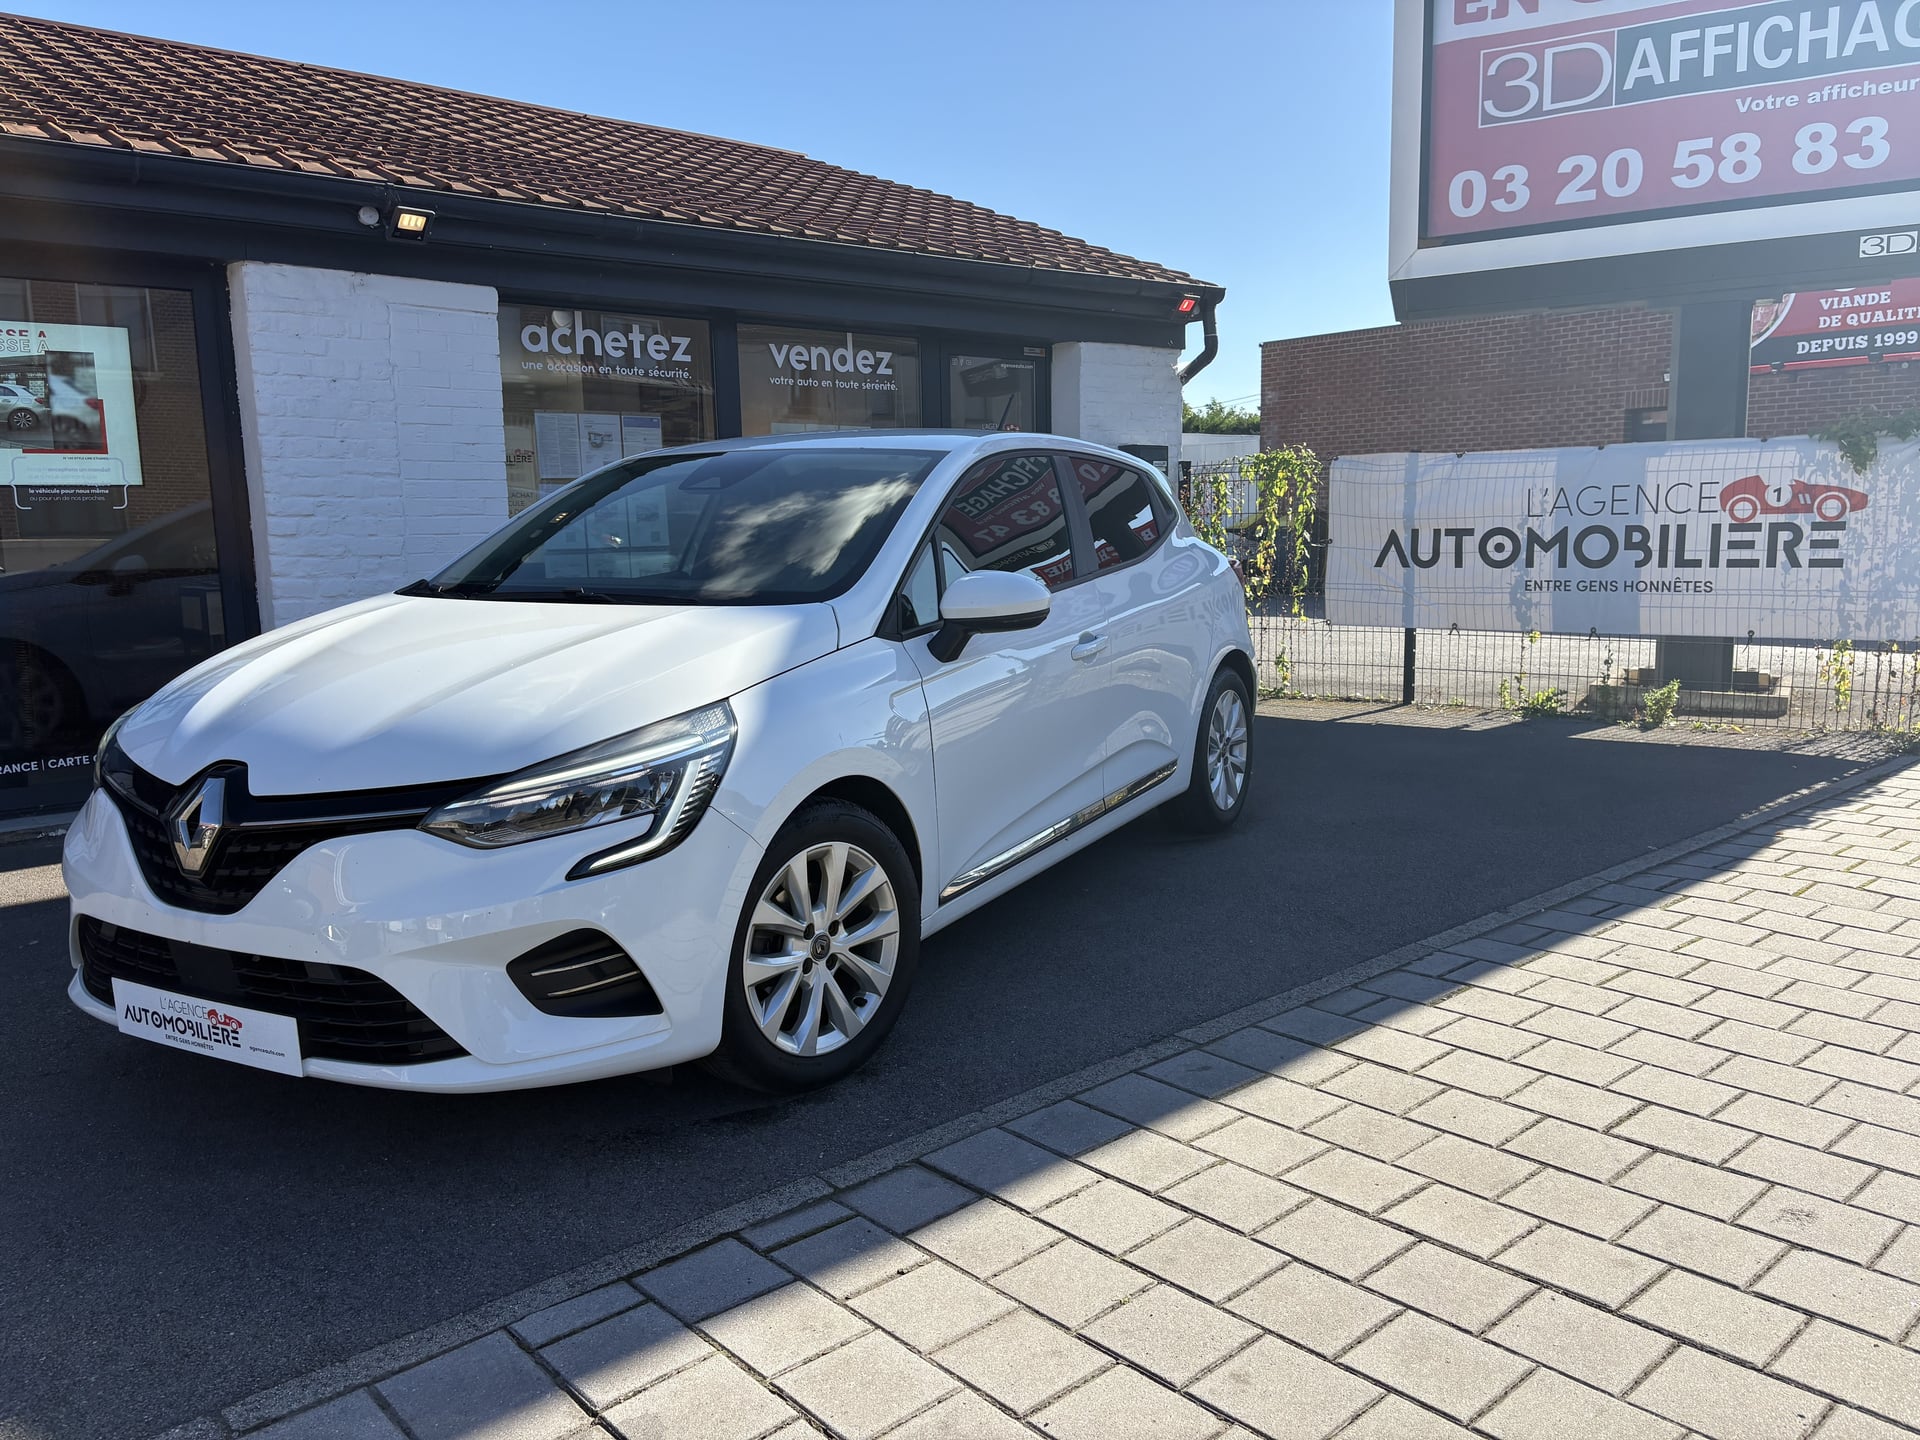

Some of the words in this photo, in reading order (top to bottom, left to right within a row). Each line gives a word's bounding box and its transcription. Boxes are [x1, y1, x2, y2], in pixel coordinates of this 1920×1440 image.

[1483, 41, 1613, 118] 3D
[1735, 96, 1800, 113] Votre
[1806, 78, 1920, 104] afficheur
[1448, 164, 1531, 218] 03
[1554, 147, 1644, 206] 20
[1670, 131, 1763, 189] 58
[1790, 115, 1891, 175] 83
[1860, 233, 1917, 256] 3D
[1818, 290, 1892, 311] VIANDE
[1818, 315, 1842, 329] DE
[520, 310, 692, 362] achetez
[1796, 334, 1869, 355] DEPUIS
[1873, 330, 1919, 348] 1999
[768, 332, 893, 375] vendez
[521, 361, 544, 371] une
[547, 360, 596, 374] occasion
[598, 367, 613, 375] en
[615, 364, 645, 377] toute
[648, 365, 692, 380] sécurité.
[769, 375, 795, 386] votre
[797, 376, 819, 387] auto
[821, 379, 833, 388] en
[835, 378, 859, 390] toute
[861, 378, 899, 391] sérénité.
[1527, 481, 1720, 518] L'AGENCE
[1373, 521, 1847, 570] AUTOMOBILIERE
[1524, 580, 1572, 593] ENTRE
[1576, 580, 1618, 593] GENS
[1623, 576, 1714, 593] HONNÊTES
[47, 754, 90, 769] CARTE
[159, 996, 208, 1020] L'AGENCE
[124, 1004, 242, 1049] AUTOMOBILIERE
